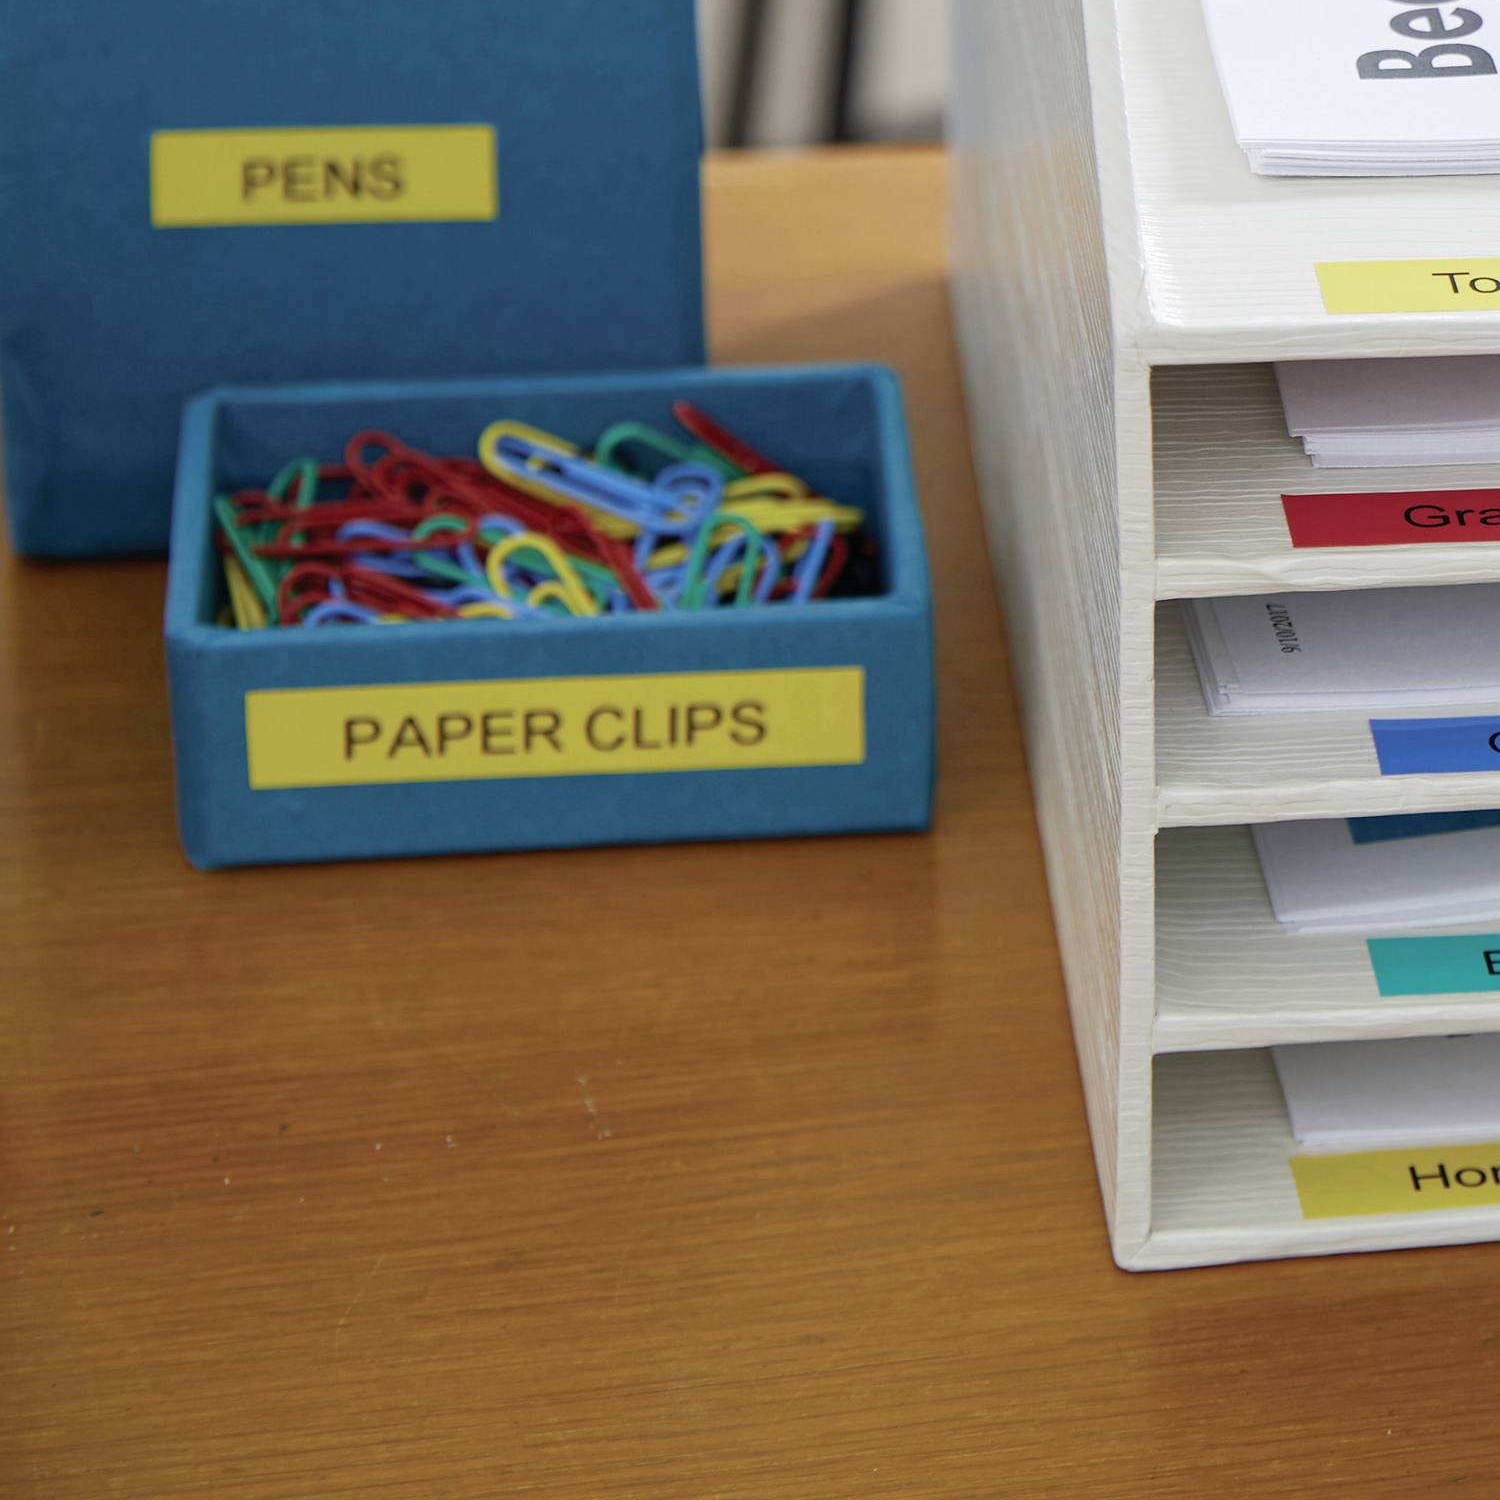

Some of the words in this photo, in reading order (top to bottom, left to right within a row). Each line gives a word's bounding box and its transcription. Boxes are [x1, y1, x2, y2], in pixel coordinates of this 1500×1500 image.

[241, 154, 408, 205] PENS
[1265, 602, 1302, 653] 9/10/2017
[344, 711, 564, 763] PAPER
[585, 701, 769, 753] CLIPS
